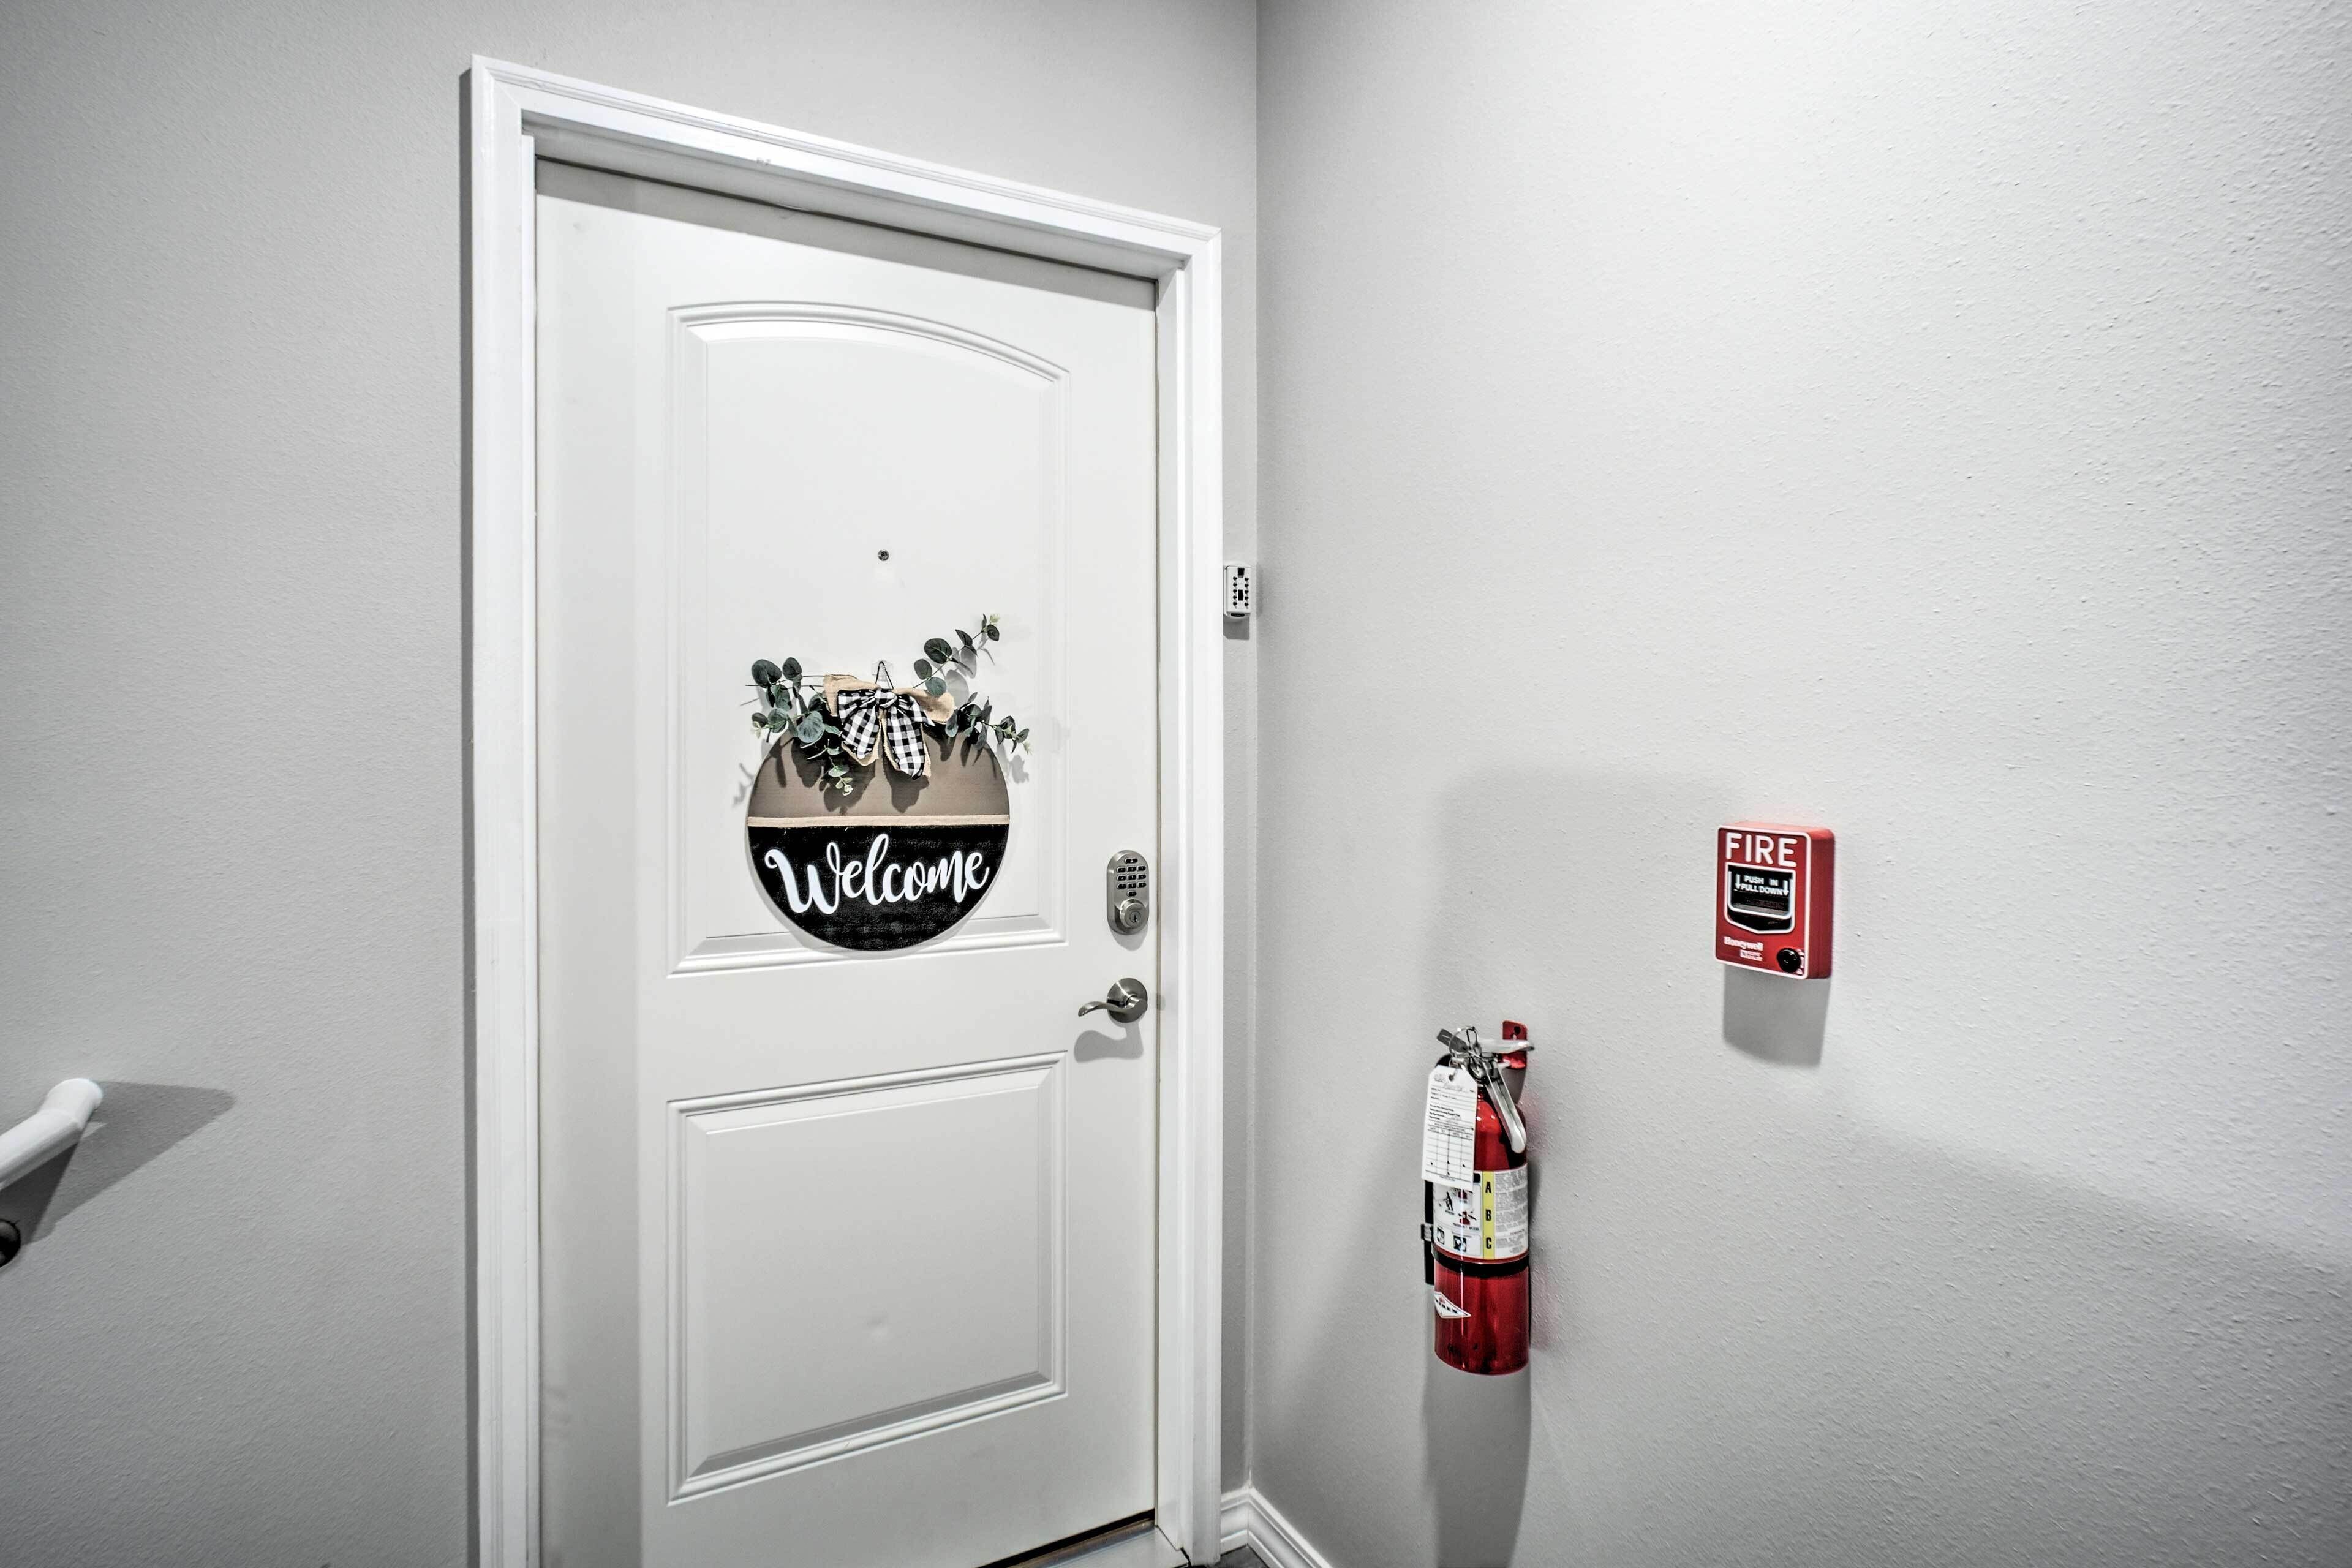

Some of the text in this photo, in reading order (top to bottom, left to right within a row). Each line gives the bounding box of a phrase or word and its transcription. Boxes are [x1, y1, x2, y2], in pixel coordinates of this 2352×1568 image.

[1725, 832, 1798, 867] FIRE
[764, 833, 990, 915] Welcome
[1744, 875, 1764, 884] PUSH
[1741, 883, 1759, 892] PULL
[1485, 1182, 1491, 1193] A
[1486, 1210, 1491, 1221] B
[1486, 1238, 1491, 1249] C
